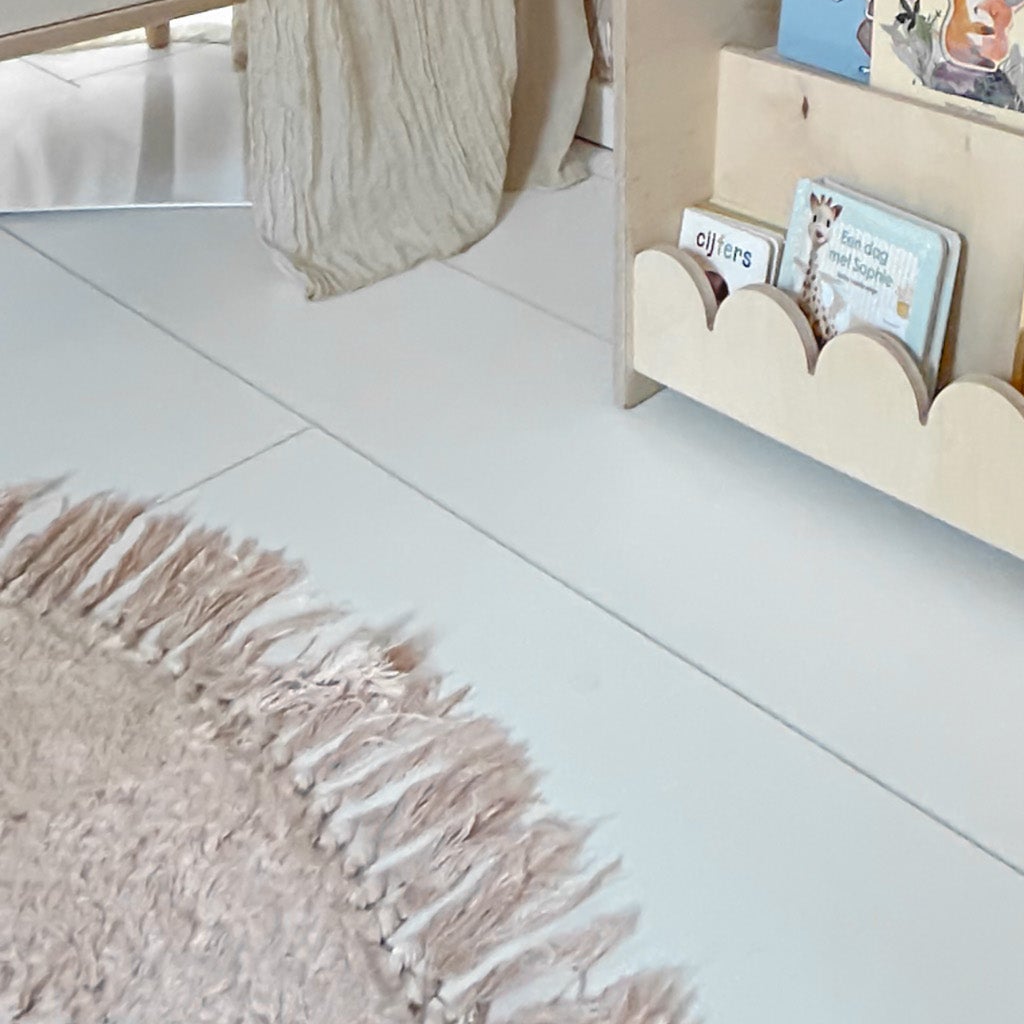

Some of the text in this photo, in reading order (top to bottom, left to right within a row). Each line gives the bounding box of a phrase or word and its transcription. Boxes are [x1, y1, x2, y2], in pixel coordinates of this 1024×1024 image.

[696, 230, 752, 268] cijfers
[864, 241, 889, 266] dag
[853, 257, 894, 287] Sophie
